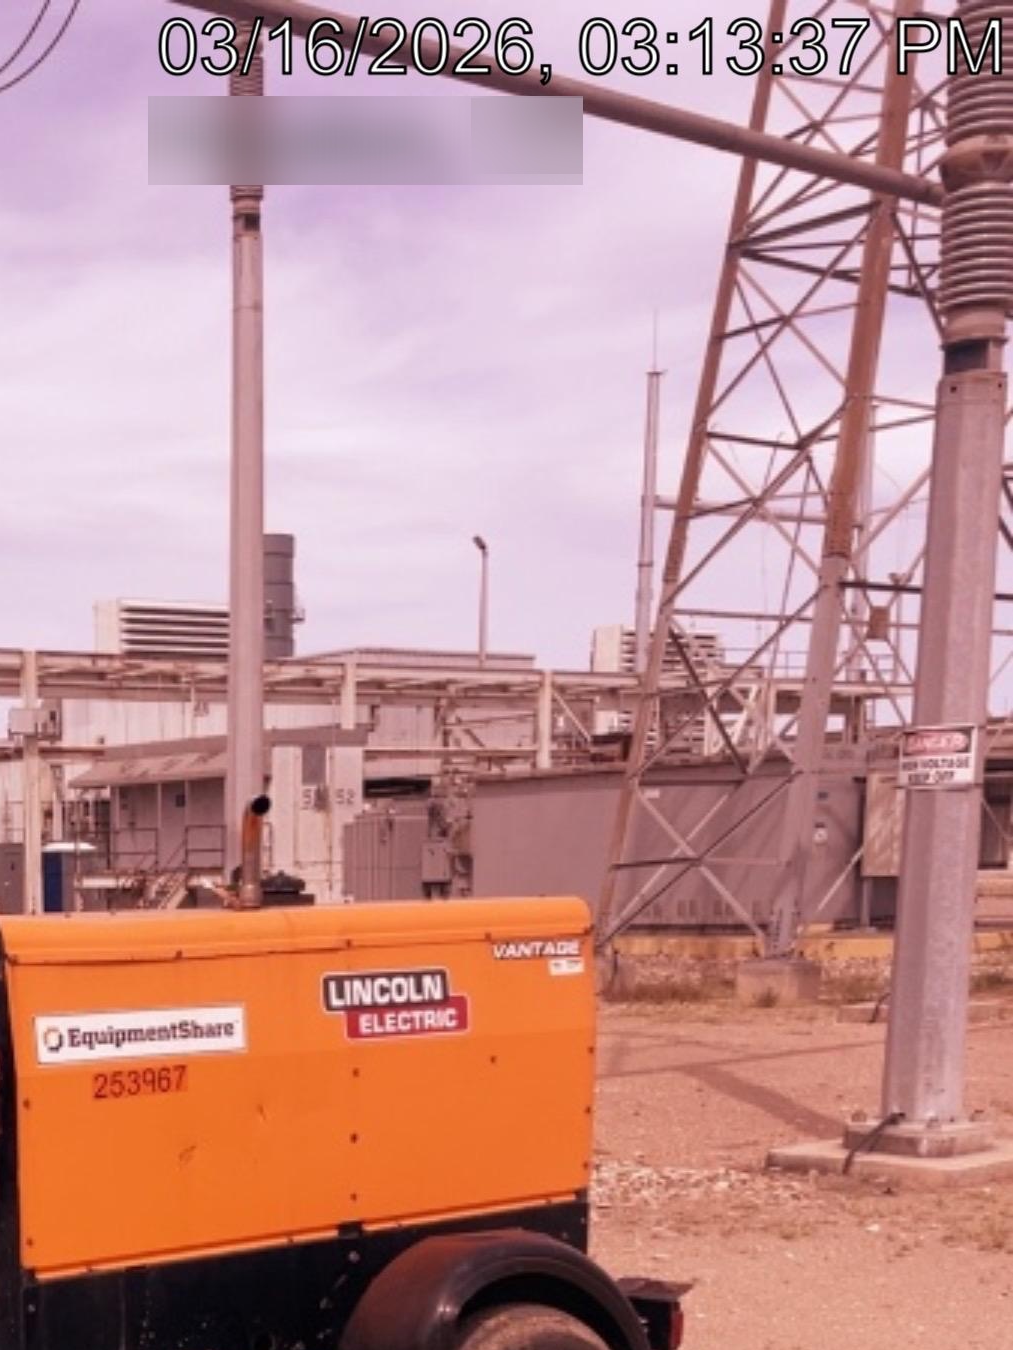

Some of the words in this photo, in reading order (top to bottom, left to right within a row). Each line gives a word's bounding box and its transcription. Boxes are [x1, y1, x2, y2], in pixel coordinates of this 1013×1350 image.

[492, 939, 580, 960] VANTAGE
[327, 974, 445, 1008] LINCOLN
[66, 1020, 235, 1051] EquipmentShare
[358, 1008, 459, 1035] ELECTRIC
[93, 1065, 187, 1100] 253967
